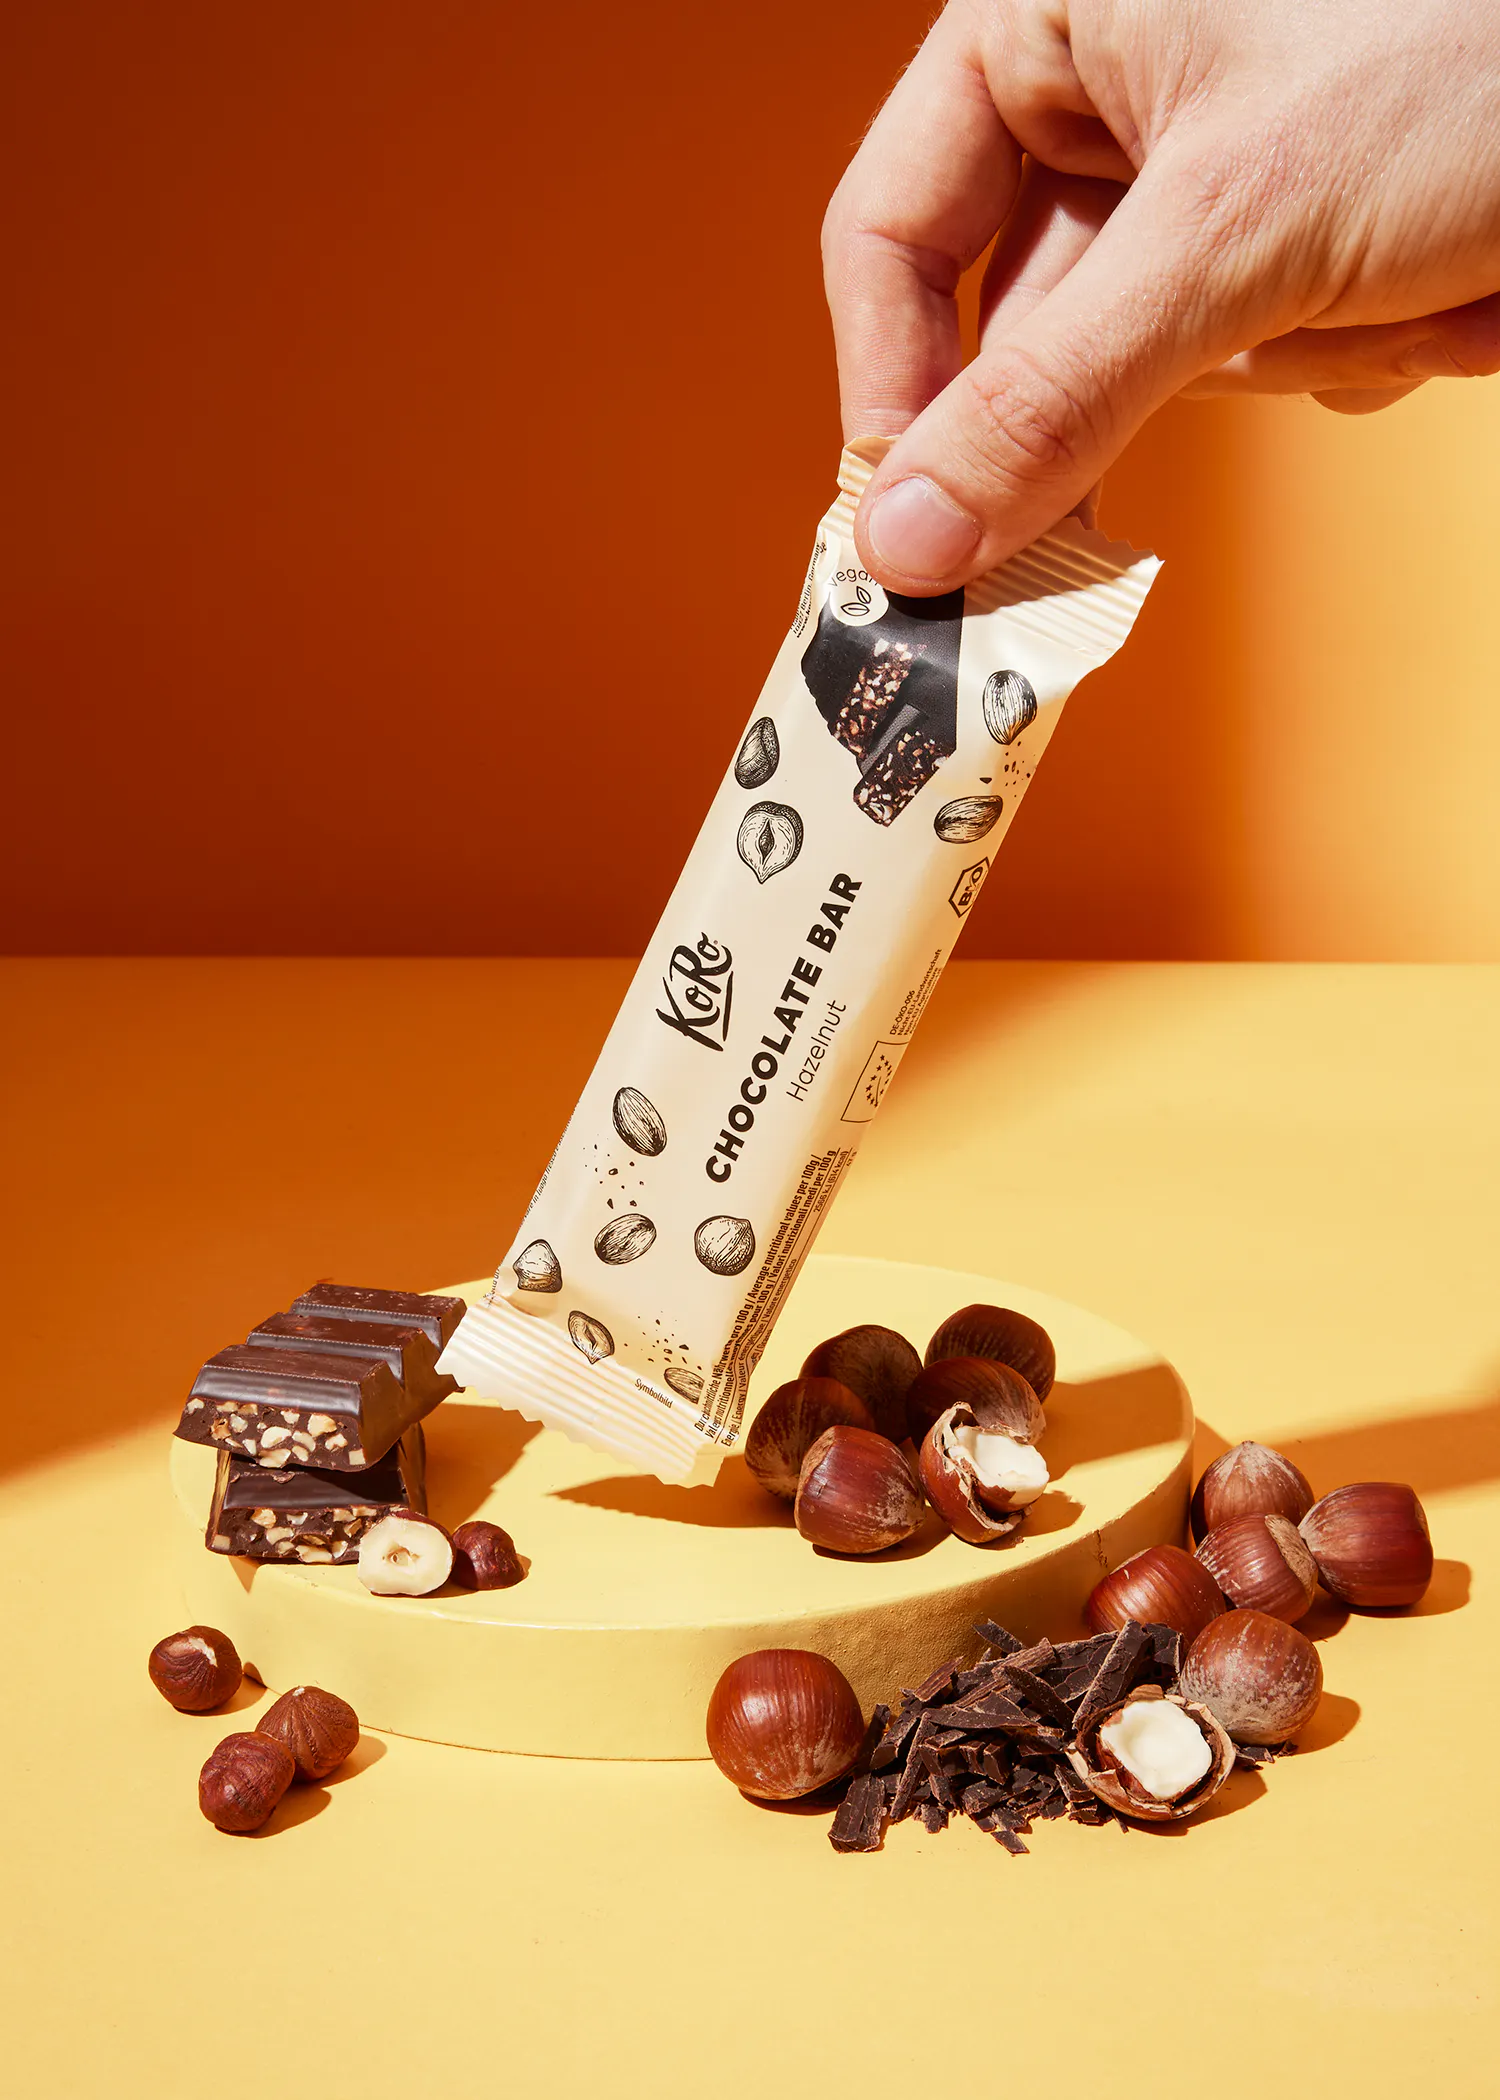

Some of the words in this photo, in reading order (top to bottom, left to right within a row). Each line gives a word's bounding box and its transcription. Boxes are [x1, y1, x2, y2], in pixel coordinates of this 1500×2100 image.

[656, 932, 733, 1051] KoRo
[890, 990, 915, 1035] DE-ÖKO-006
[705, 956, 823, 1183] CHOCOLATE
[806, 873, 862, 953] BAR
[786, 999, 846, 1101] Hazelnut
[801, 1160, 820, 1178] 100g
[818, 1156, 832, 1171] 100
[796, 1180, 808, 1194] per
[813, 1172, 824, 1186] per
[785, 1194, 802, 1221] values
[803, 1186, 818, 1207] medi
[765, 1221, 790, 1265] nutritional
[782, 1208, 808, 1253] nutrizionali
[768, 1255, 787, 1278] Valori
[748, 1266, 770, 1299] Average
[756, 1289, 770, 1303] 100
[735, 1309, 749, 1323] 100
[749, 1305, 762, 1322] pour
[730, 1325, 742, 1338] pro
[738, 1363, 747, 1388] Valeur
[762, 1296, 779, 1318] Valore
[634, 1378, 674, 1408] Symbolbild
